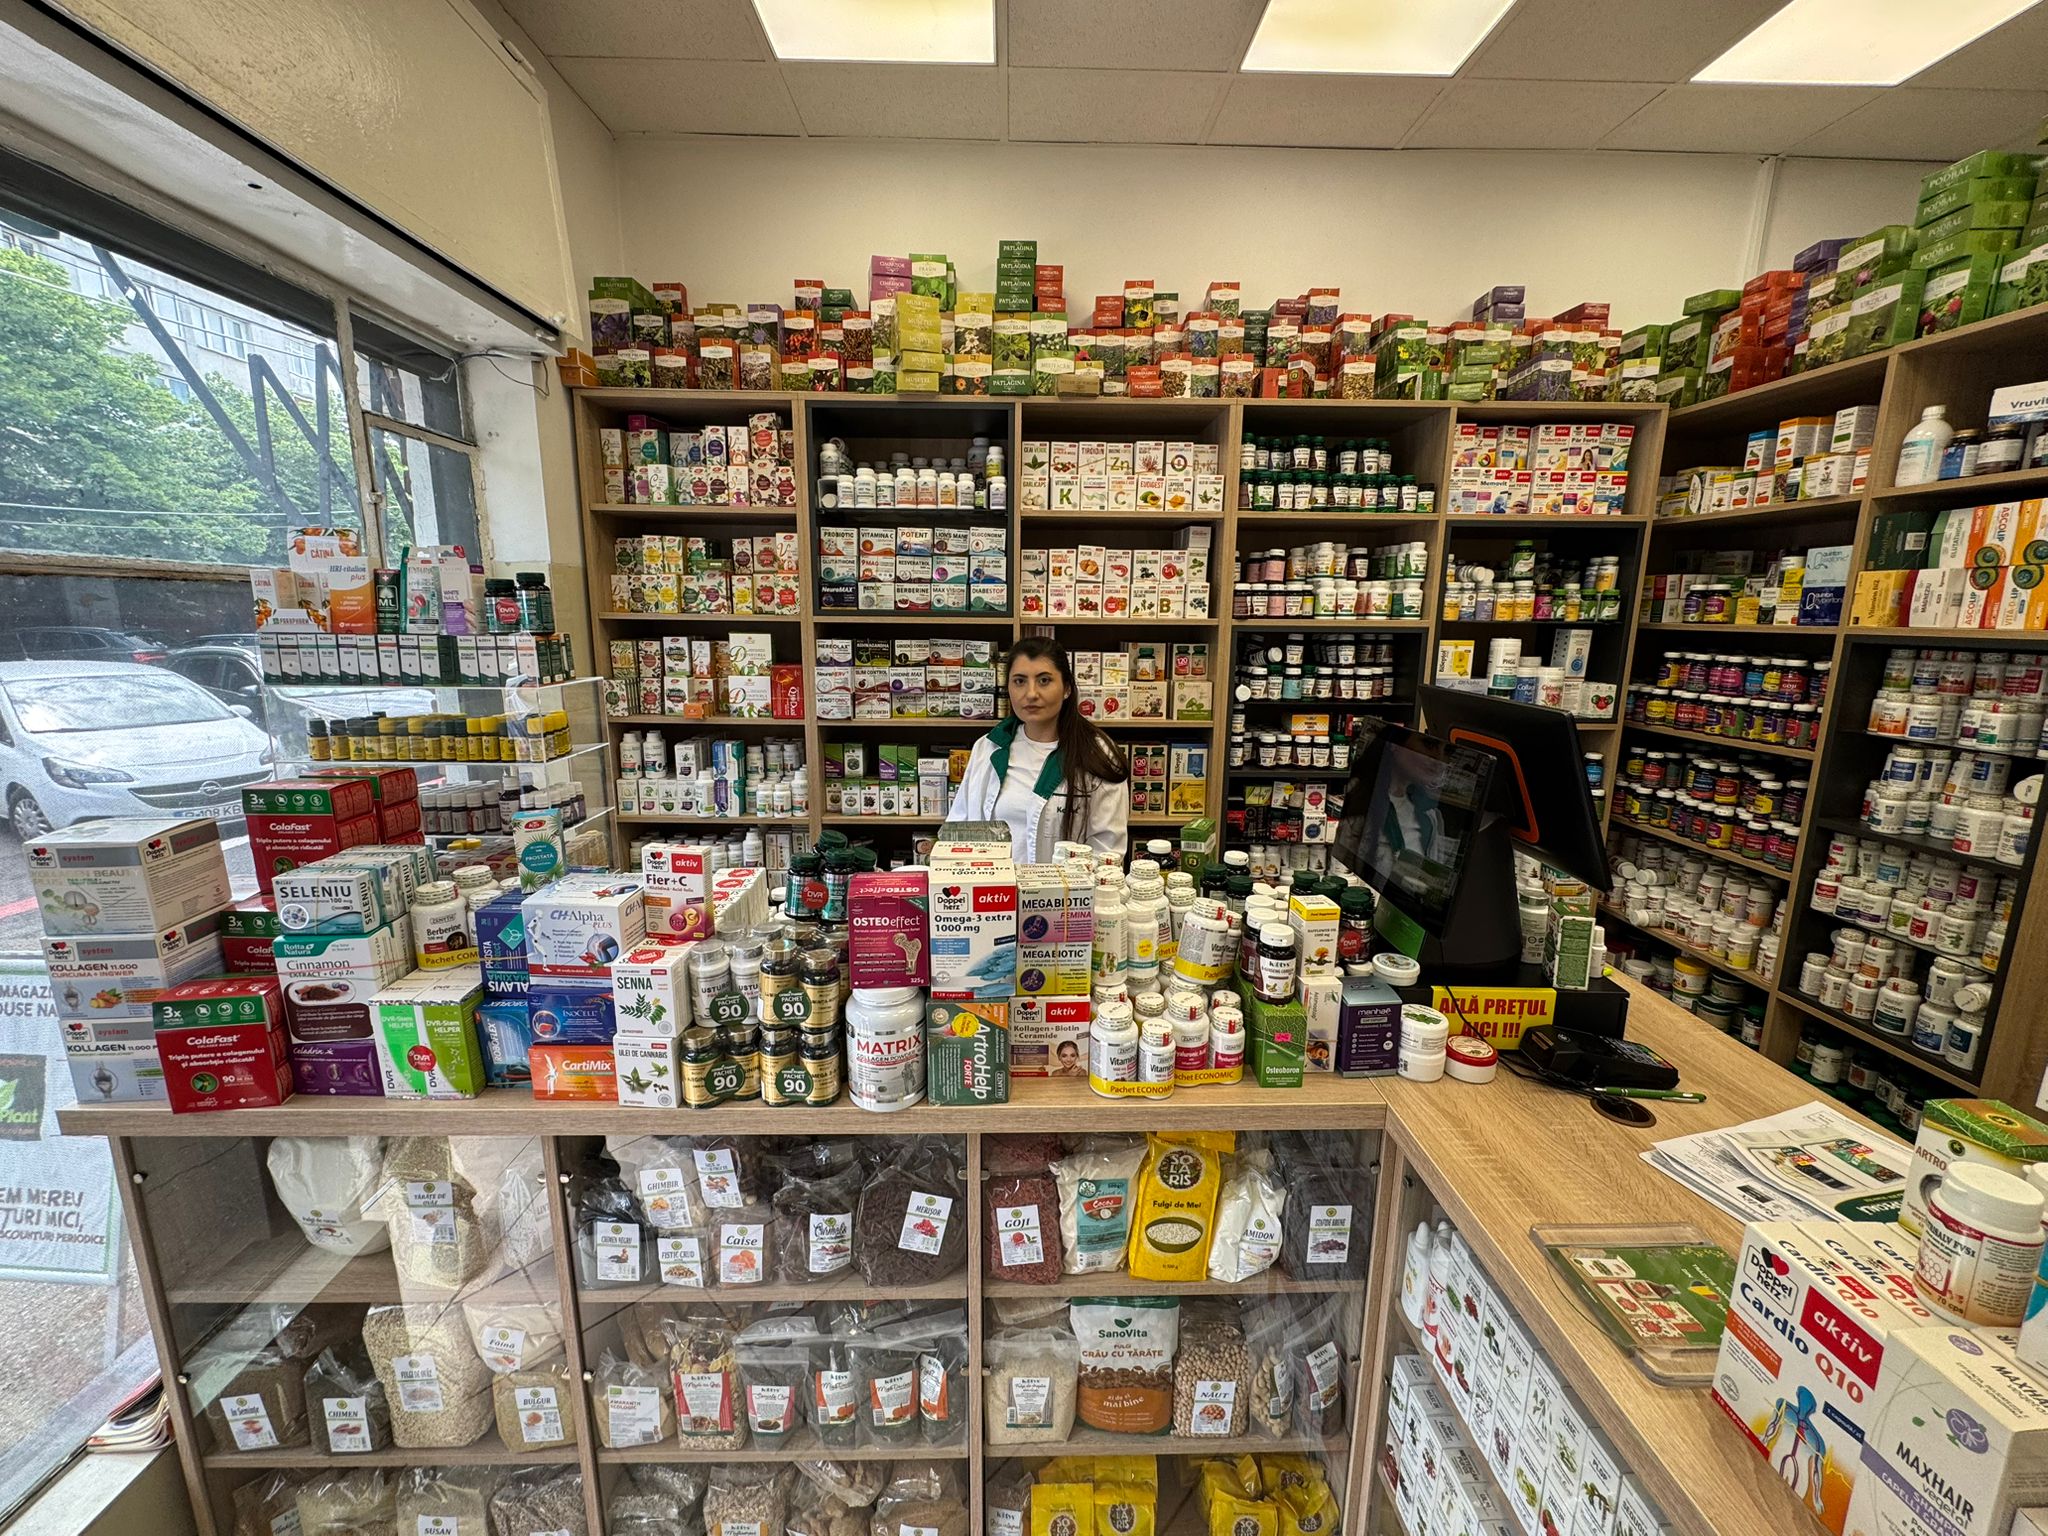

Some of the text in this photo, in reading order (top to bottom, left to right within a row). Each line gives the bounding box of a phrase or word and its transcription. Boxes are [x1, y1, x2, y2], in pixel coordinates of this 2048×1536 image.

[1060, 488, 1072, 504] K
[270, 823, 311, 831] ColaFast
[63, 855, 94, 863] system
[525, 853, 555, 861] PROSTATA
[676, 860, 698, 868] aktiv
[402, 864, 414, 904] SELENIU
[280, 886, 351, 898] SELENIU
[360, 881, 373, 925] SELENIU
[937, 896, 966, 904] Doppel
[978, 894, 1011, 904] aktiv
[1022, 897, 1091, 909] MEGABIOTIC
[934, 914, 982, 926] Omega-3
[1060, 911, 1093, 919] FEMINA
[426, 923, 462, 936] Berberine
[935, 924, 980, 934] 1000 mg
[425, 953, 455, 965] Pachet
[1022, 950, 1084, 958] MEGABIOTIC
[50, 963, 109, 972] KOLLAGEN
[286, 959, 351, 971] Cinnamon
[488, 980, 530, 992] ALAVIS
[617, 976, 653, 991] SENNA
[162, 1006, 181, 1018] 3x
[718, 1004, 742, 1019] 90
[781, 1001, 805, 1017] 90
[1050, 1007, 1077, 1016] aktiv
[1439, 994, 1547, 1020] AFLĂ PREȚUL
[1461, 1021, 1498, 1039] AICI
[186, 1035, 241, 1046] ColaFast
[857, 1031, 922, 1056] MATRIX
[67, 1044, 126, 1053] KOLLAGEN
[190, 1052, 215, 1060] putere
[222, 1048, 265, 1058] colagenului
[640, 1050, 669, 1059] CANNABIS
[562, 1060, 612, 1071] CartiMix
[970, 1023, 992, 1100] ArtroHelp
[964, 1059, 973, 1086] FORTE
[1195, 1070, 1234, 1080] ECONOMIC
[1266, 1066, 1300, 1074] Osteoboron
[222, 1075, 235, 1083] 90
[713, 1077, 738, 1091] 90
[783, 1079, 807, 1093] 90
[1110, 1085, 1135, 1093] Pachet
[1916, 1145, 1947, 1171] ARTRO
[647, 1181, 680, 1191] GHIMBIR
[1168, 1175, 1191, 1186] RIS
[1152, 1200, 1173, 1209] Fulgi
[1174, 1200, 1185, 1208] de
[1004, 1217, 1031, 1229] GOJI
[726, 1235, 758, 1247] Caise
[1777, 1238, 1836, 1286] Cardio
[1825, 1238, 1885, 1286] Cardio
[1750, 1251, 1793, 1297] Doppel
[1756, 1270, 1782, 1301] herz
[1836, 1288, 1880, 1320] Q10
[1887, 1289, 1932, 1319] Q10
[1937, 1295, 1965, 1315] 70 cps
[1740, 1282, 1809, 1356] Cardio
[1098, 1328, 1148, 1338] SanoVita
[1813, 1310, 1874, 1366] aktiv
[1111, 1350, 1125, 1358] CU
[1814, 1352, 1864, 1404] Q10
[1103, 1396, 1145, 1408] mai bine
[328, 1410, 359, 1418] CHIMEN
[1896, 1441, 1974, 1522] MAXHAIR
[1881, 1472, 1921, 1516] CAPELLI
[425, 1527, 452, 1536] SUSAN
